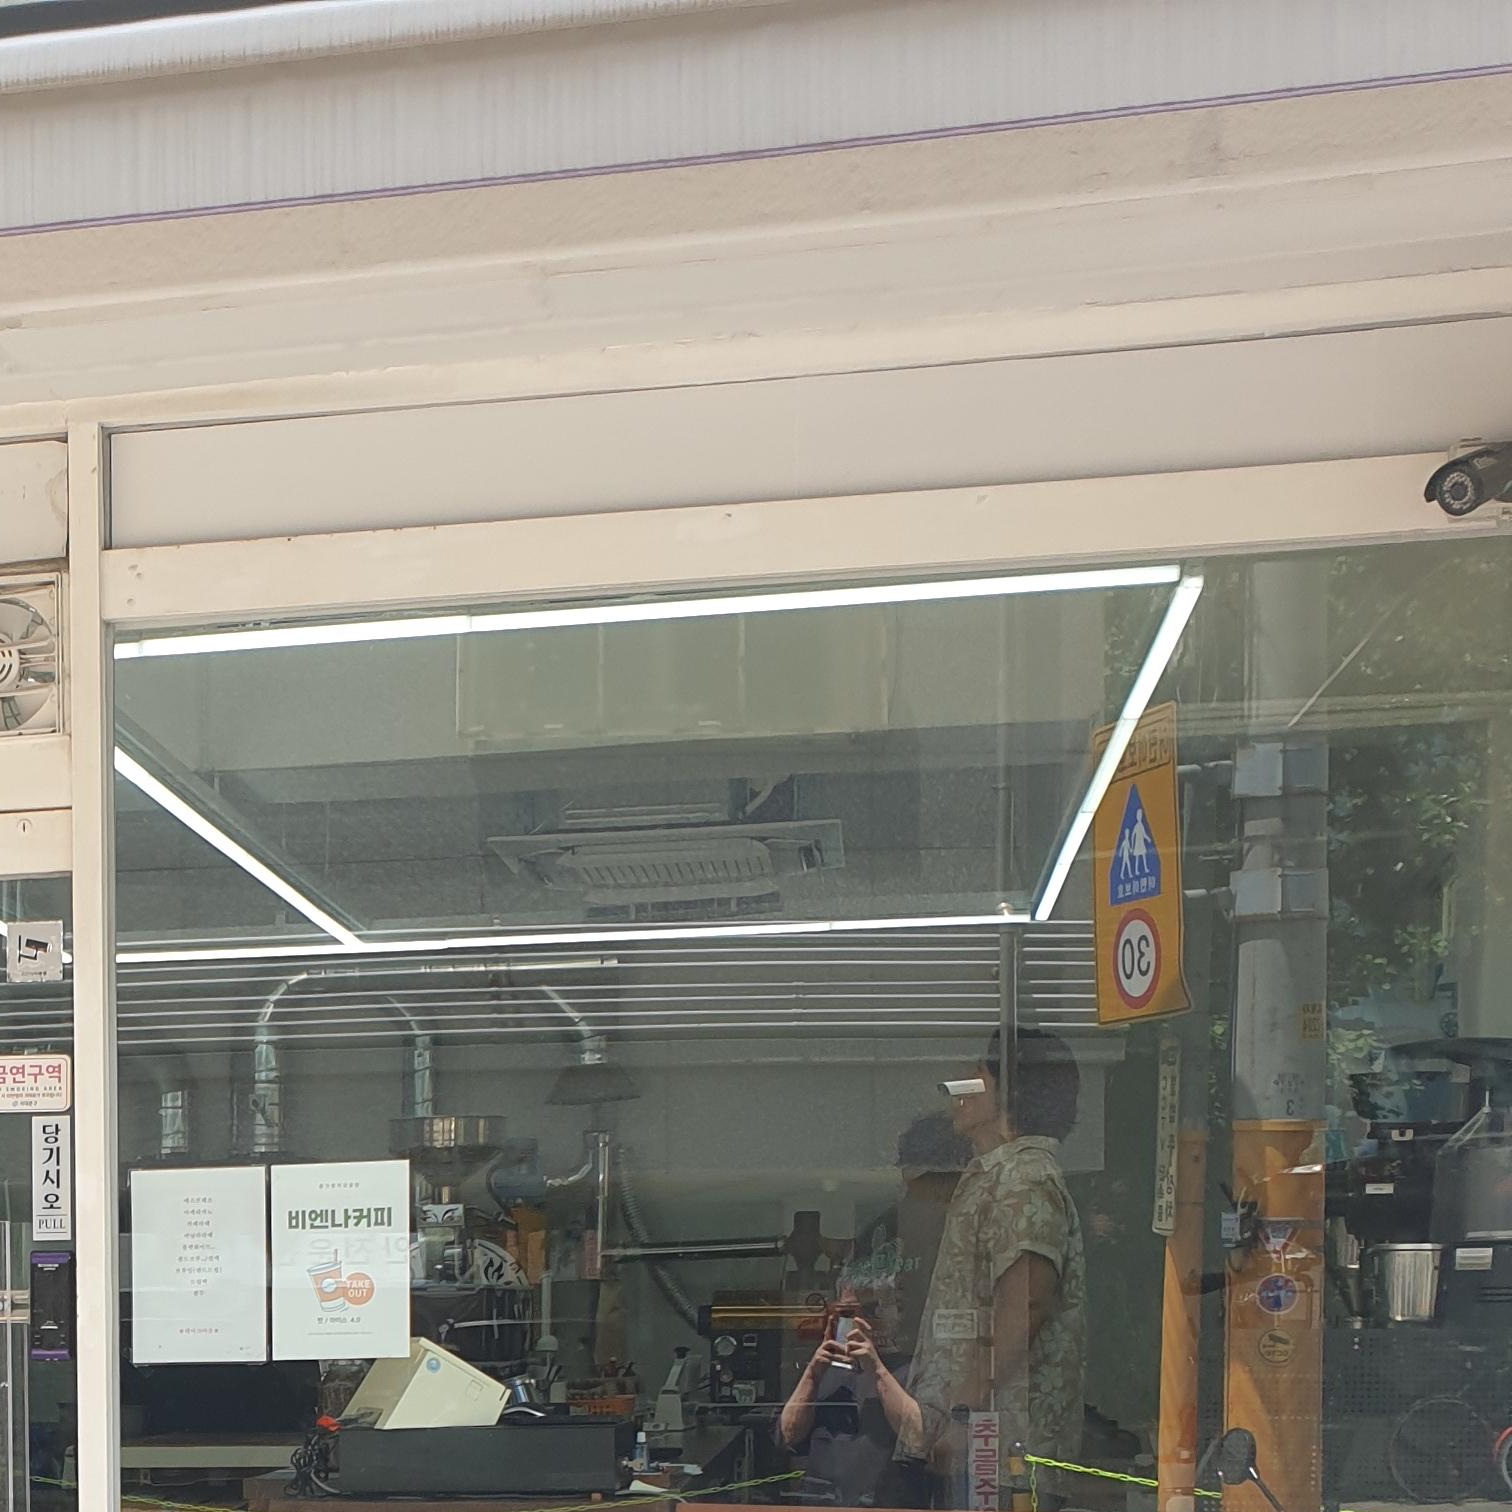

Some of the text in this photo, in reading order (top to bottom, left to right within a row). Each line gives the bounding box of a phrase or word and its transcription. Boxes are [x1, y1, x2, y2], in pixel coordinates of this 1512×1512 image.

[41, 1123, 63, 1211] 당기시오
[288, 1206, 392, 1230] 비엔나커피
[38, 1219, 66, 1230] PULL
[347, 1279, 371, 1289] TAKE
[348, 1288, 368, 1297] OUT
